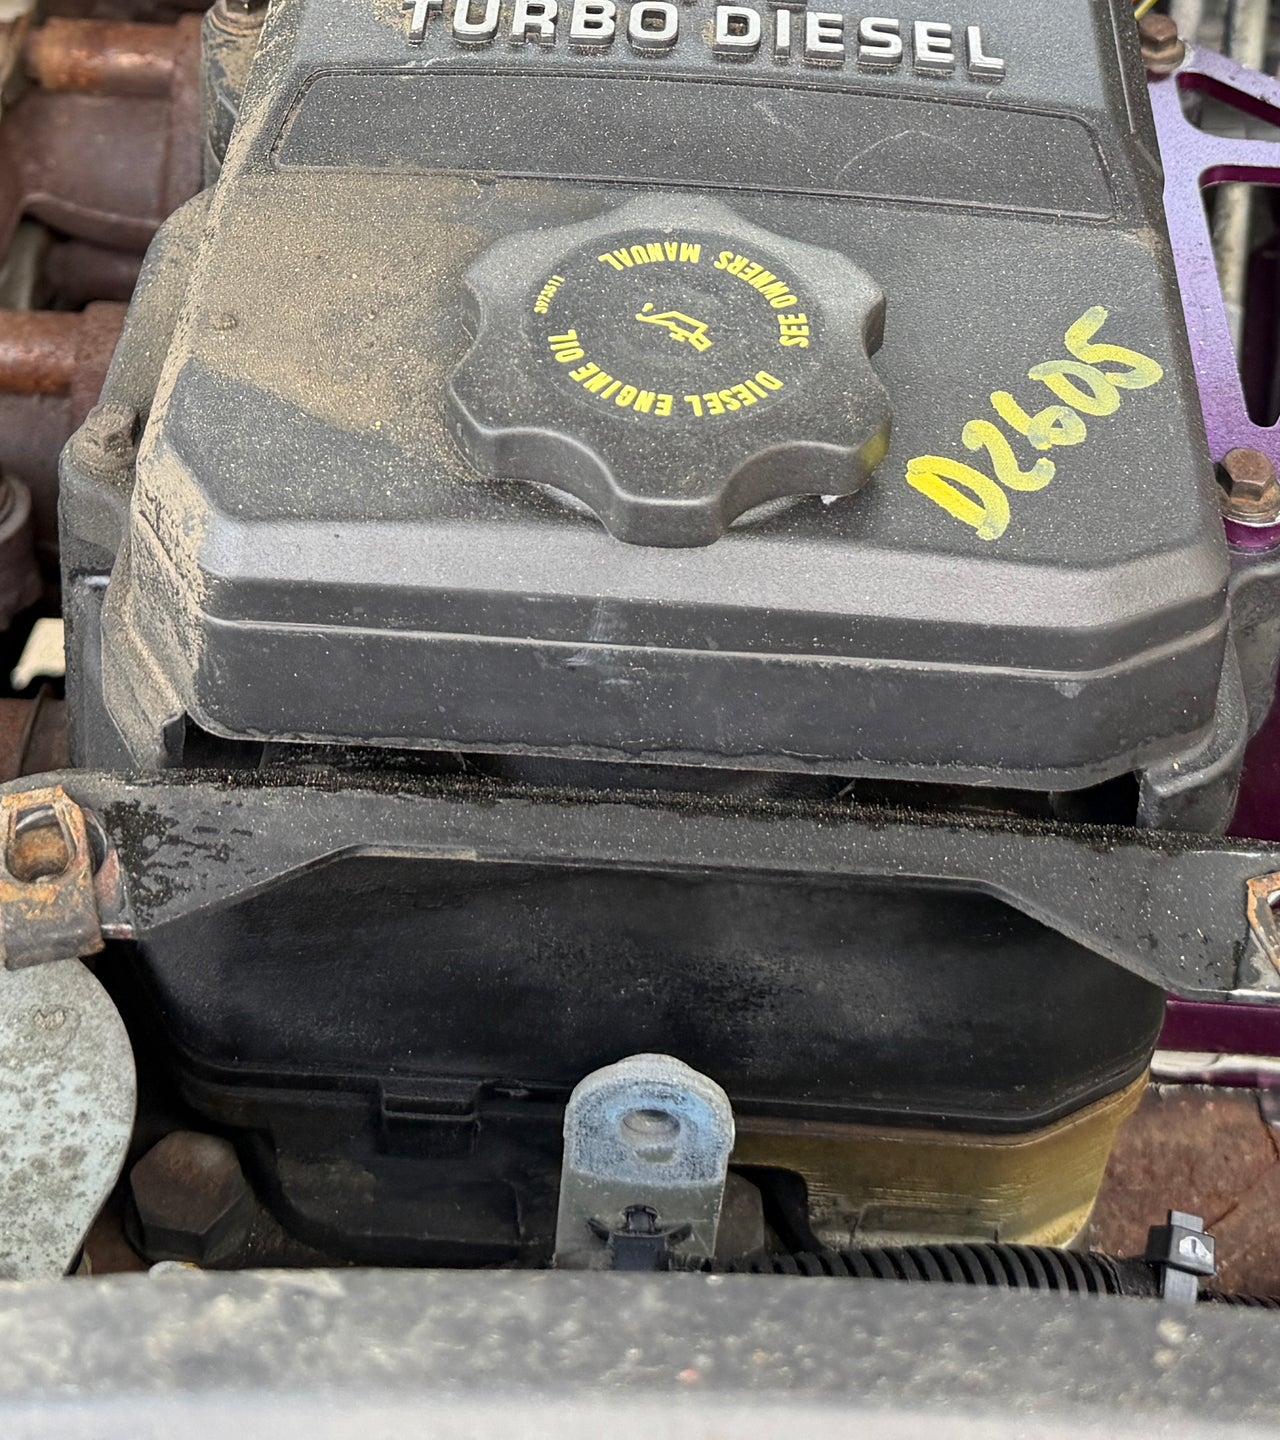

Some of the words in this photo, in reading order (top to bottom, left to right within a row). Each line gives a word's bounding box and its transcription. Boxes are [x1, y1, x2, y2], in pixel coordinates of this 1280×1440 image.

[712, 5, 1006, 77] DIESEL
[598, 241, 702, 272] MANUAL
[715, 249, 799, 311] OWNERS
[547, 328, 586, 364] OIL
[778, 311, 811, 349] SEE
[569, 362, 674, 418] ENGINE
[685, 370, 784, 418] DIESEL
